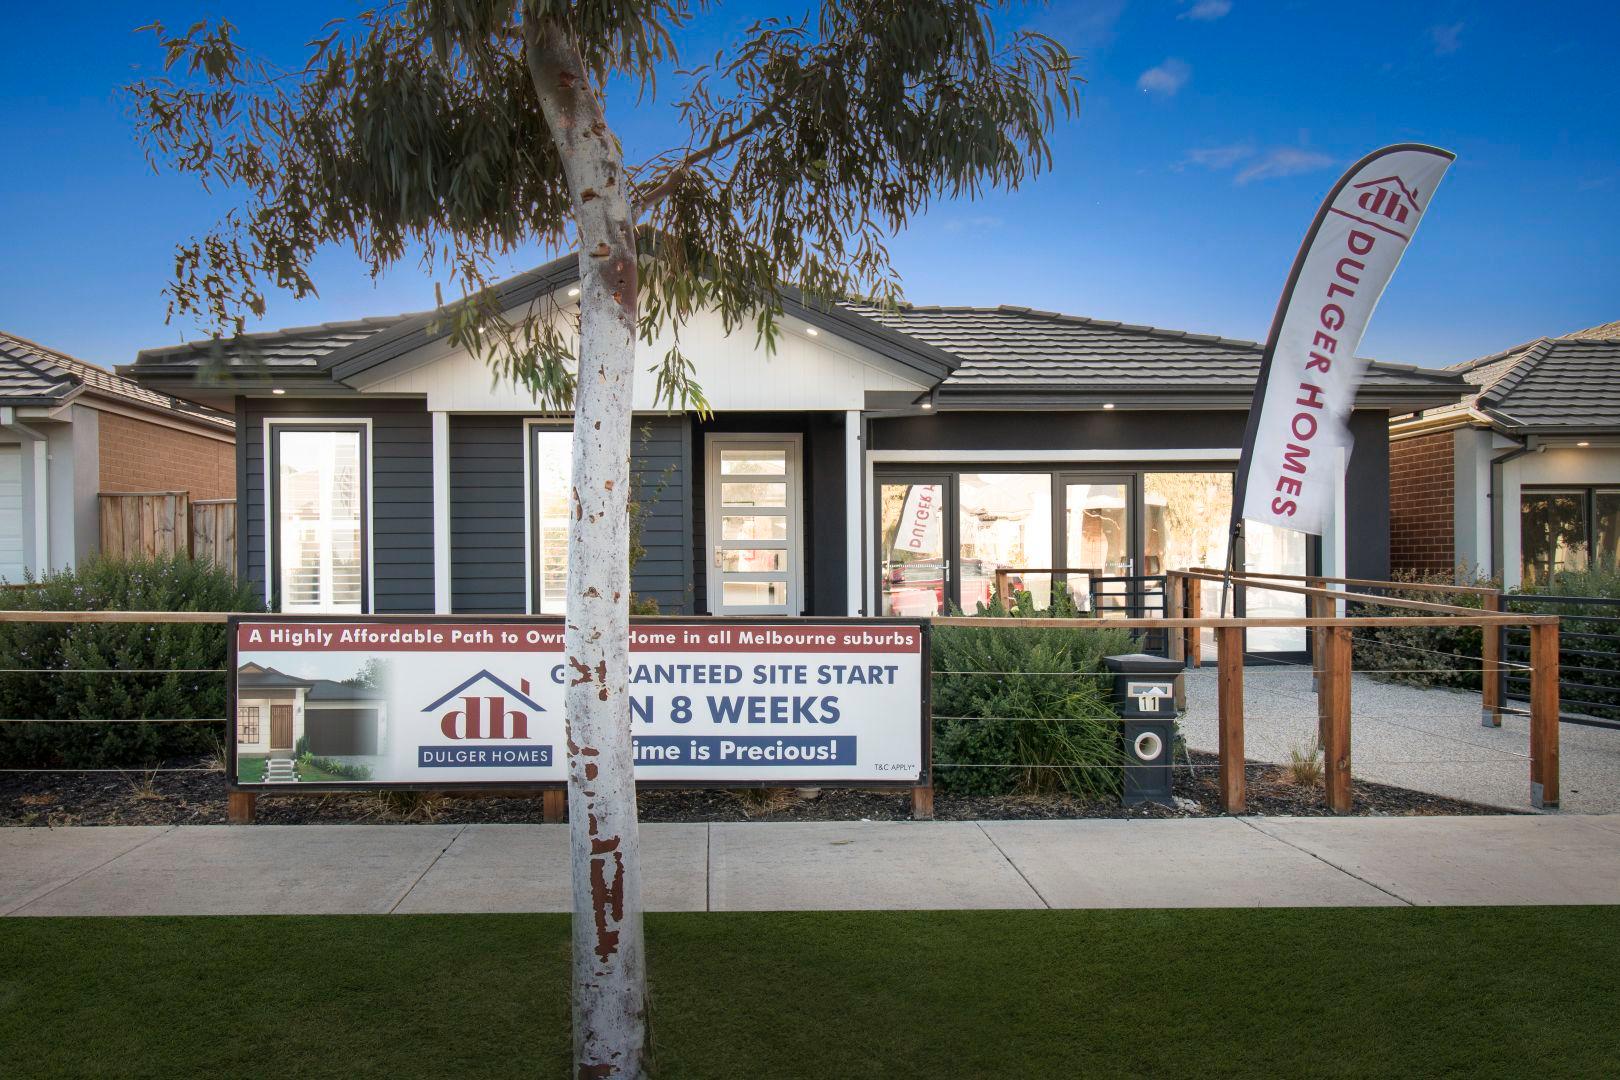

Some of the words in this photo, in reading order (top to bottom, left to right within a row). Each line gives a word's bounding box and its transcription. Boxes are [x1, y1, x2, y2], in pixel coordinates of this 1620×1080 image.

[1305, 229, 1376, 375] DULGER
[1270, 381, 1324, 518] HOMES
[249, 629, 263, 643] A
[270, 629, 333, 646] Highly
[340, 628, 444, 644] Affordable
[451, 629, 494, 644] Path
[501, 631, 519, 644] to
[683, 630, 701, 644] in
[708, 630, 731, 645] all
[738, 631, 837, 646] Melbourne
[843, 631, 915, 646] suburbs
[550, 664, 743, 685] GANTEED
[752, 664, 807, 685] SITE
[817, 664, 899, 685] START
[629, 696, 654, 724] N
[670, 696, 693, 724] 8
[707, 695, 841, 724] WEEKS
[1142, 697, 1156, 710] 11
[440, 696, 532, 740] dh
[423, 750, 487, 763] DULGER
[492, 750, 549, 762] HOMES
[633, 740, 681, 760] ime
[690, 740, 711, 760] is
[720, 740, 837, 761] Precious!
[874, 763, 889, 771] T&C
